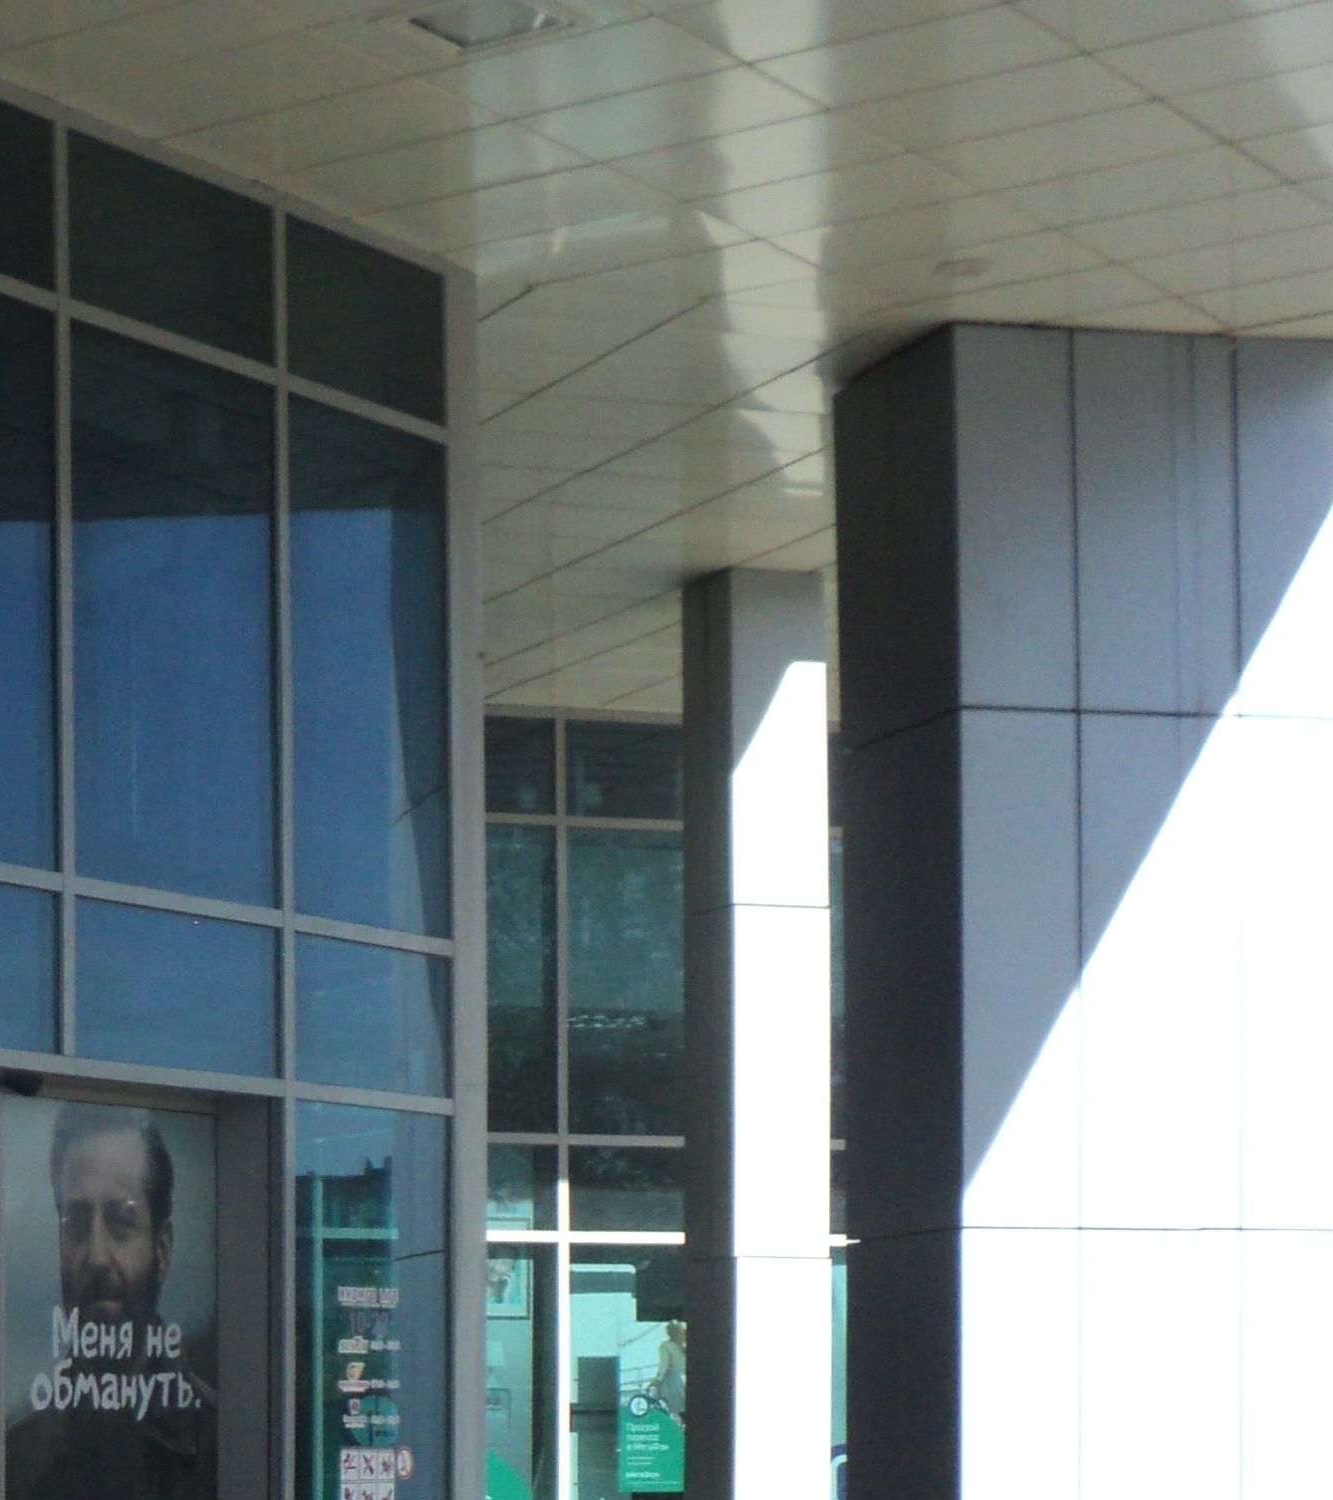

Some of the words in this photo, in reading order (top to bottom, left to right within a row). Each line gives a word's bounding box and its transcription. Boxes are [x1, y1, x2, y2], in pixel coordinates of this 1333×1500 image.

[52, 1305, 133, 1360] Меня
[146, 1322, 182, 1358] не
[30, 1357, 201, 1421] обмануть.
